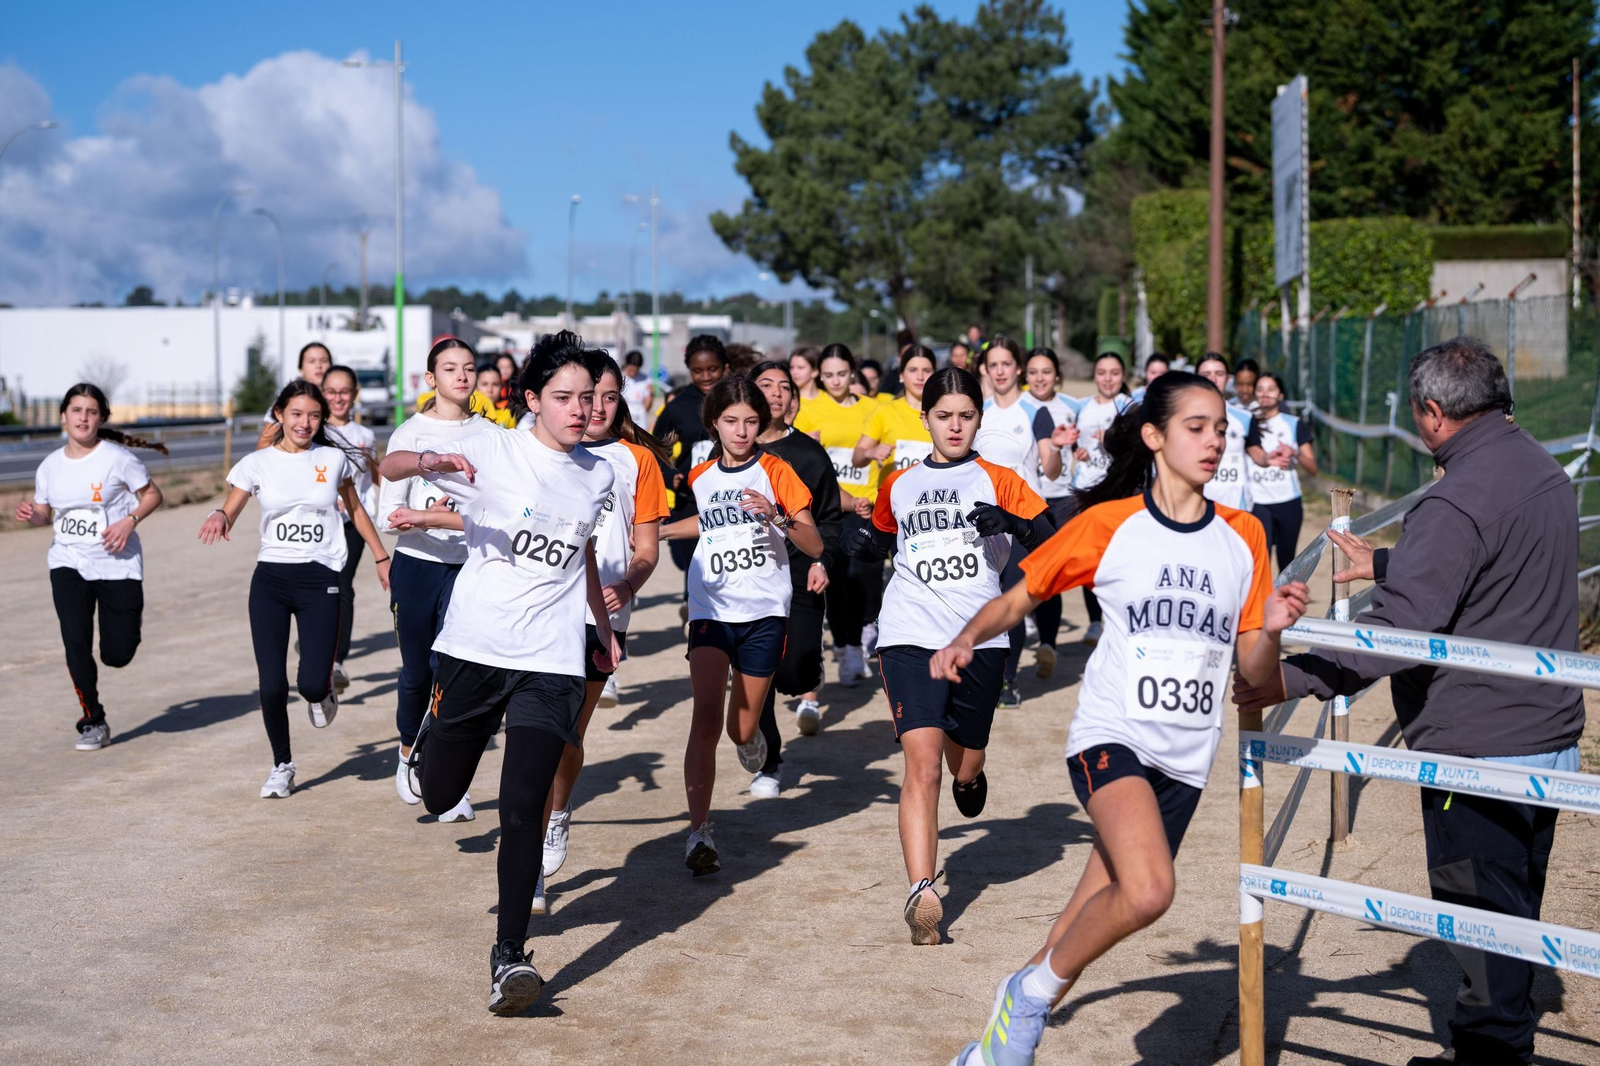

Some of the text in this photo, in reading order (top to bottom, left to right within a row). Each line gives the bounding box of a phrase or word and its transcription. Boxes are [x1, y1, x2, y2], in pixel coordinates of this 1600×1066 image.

[709, 489, 744, 504] ANA
[916, 489, 960, 506] ANA
[61, 516, 98, 537] 0264
[699, 506, 765, 533] MOGA
[901, 508, 977, 540] MOGA
[276, 522, 324, 543] 0259
[512, 530, 580, 570] 0267
[711, 545, 766, 575] 0335
[916, 553, 979, 584] 0339
[1156, 565, 1215, 597] ANA
[1126, 597, 1232, 645] MOGAS
[1381, 634, 1427, 650] DEPORTE
[1450, 643, 1490, 659] XUNTA
[1138, 676, 1214, 715] 0338
[1269, 743, 1304, 757] XUNTA
[1371, 757, 1417, 773] DEPORTE
[1441, 766, 1480, 781] XUNTA
[1290, 885, 1324, 901] XUNTA
[1390, 906, 1434, 925] DEPORTE
[1458, 920, 1496, 938] XUNTA
[1476, 937, 1523, 956] GALICIA
